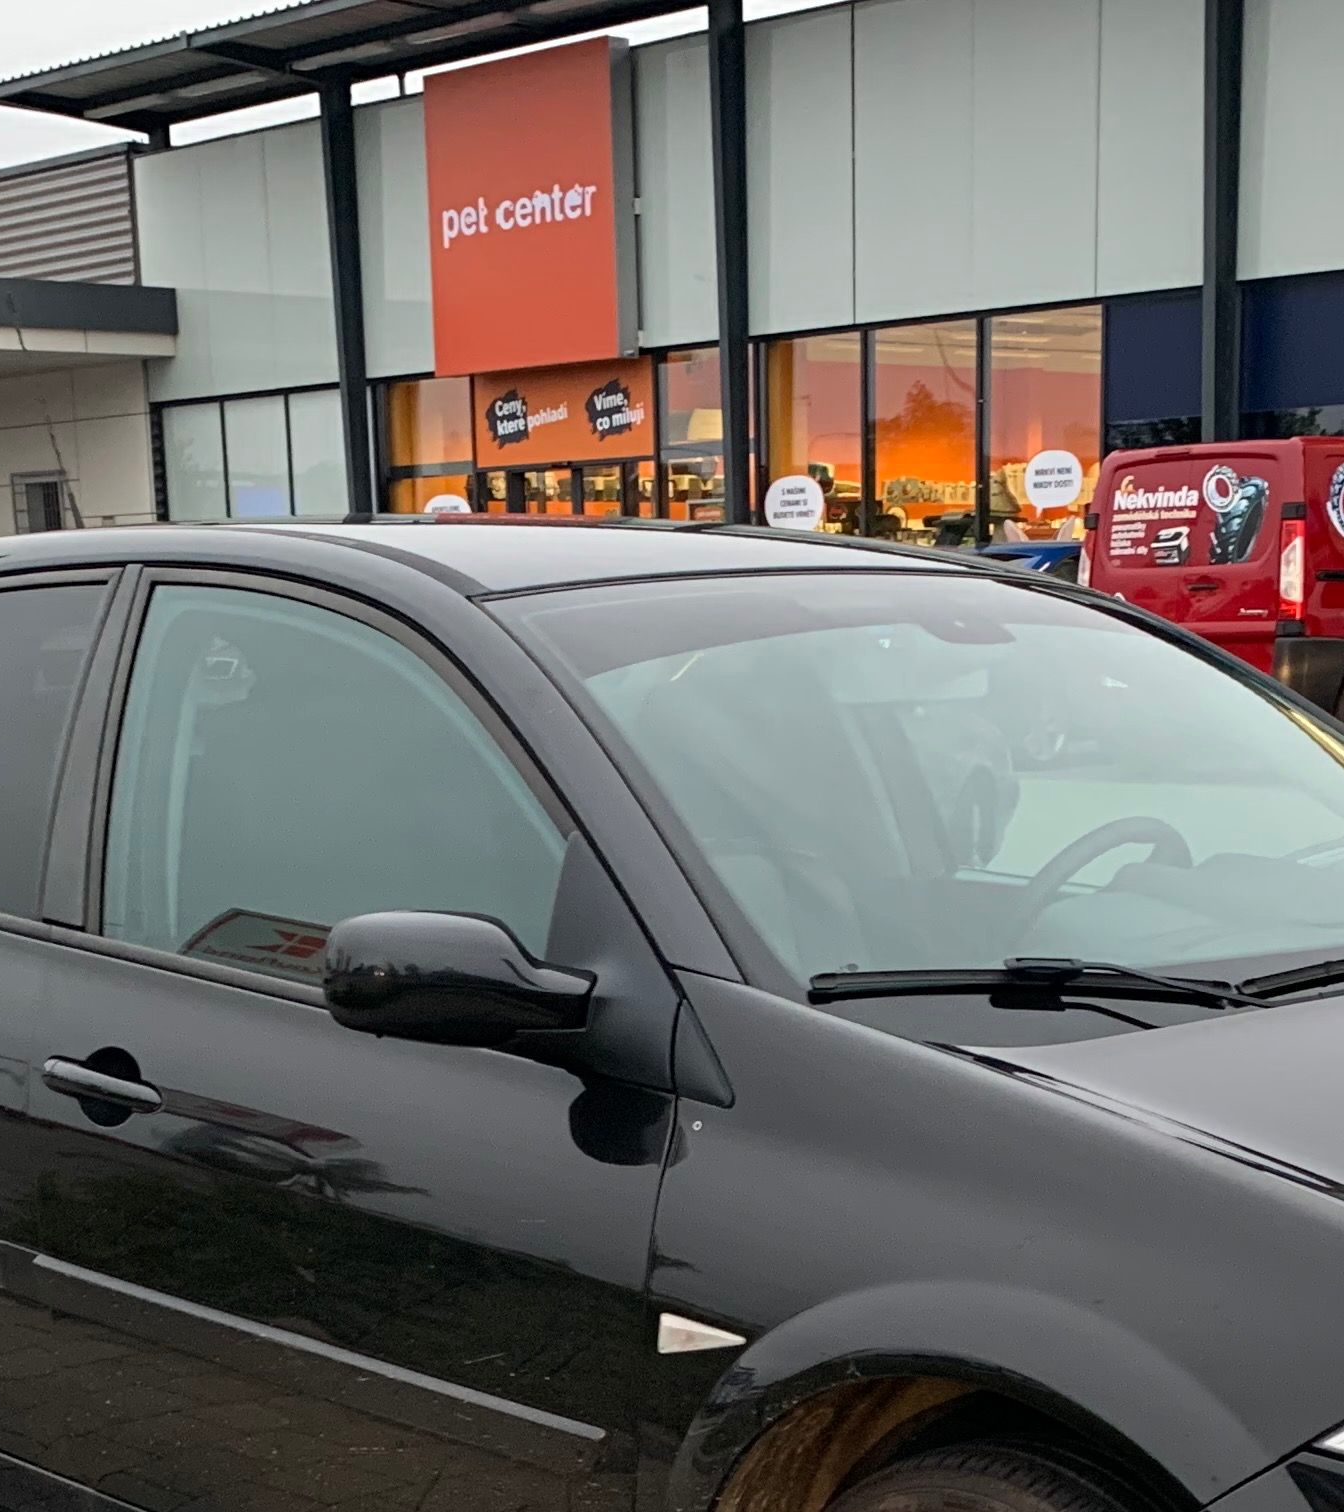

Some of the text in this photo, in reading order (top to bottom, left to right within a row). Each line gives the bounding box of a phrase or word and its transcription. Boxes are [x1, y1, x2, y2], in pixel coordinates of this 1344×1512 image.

[442, 183, 597, 249] pet center
[495, 392, 628, 417] Ceny, Víme,
[496, 417, 526, 436] které
[596, 416, 610, 431] co
[1113, 485, 1199, 511] Nekvinda
